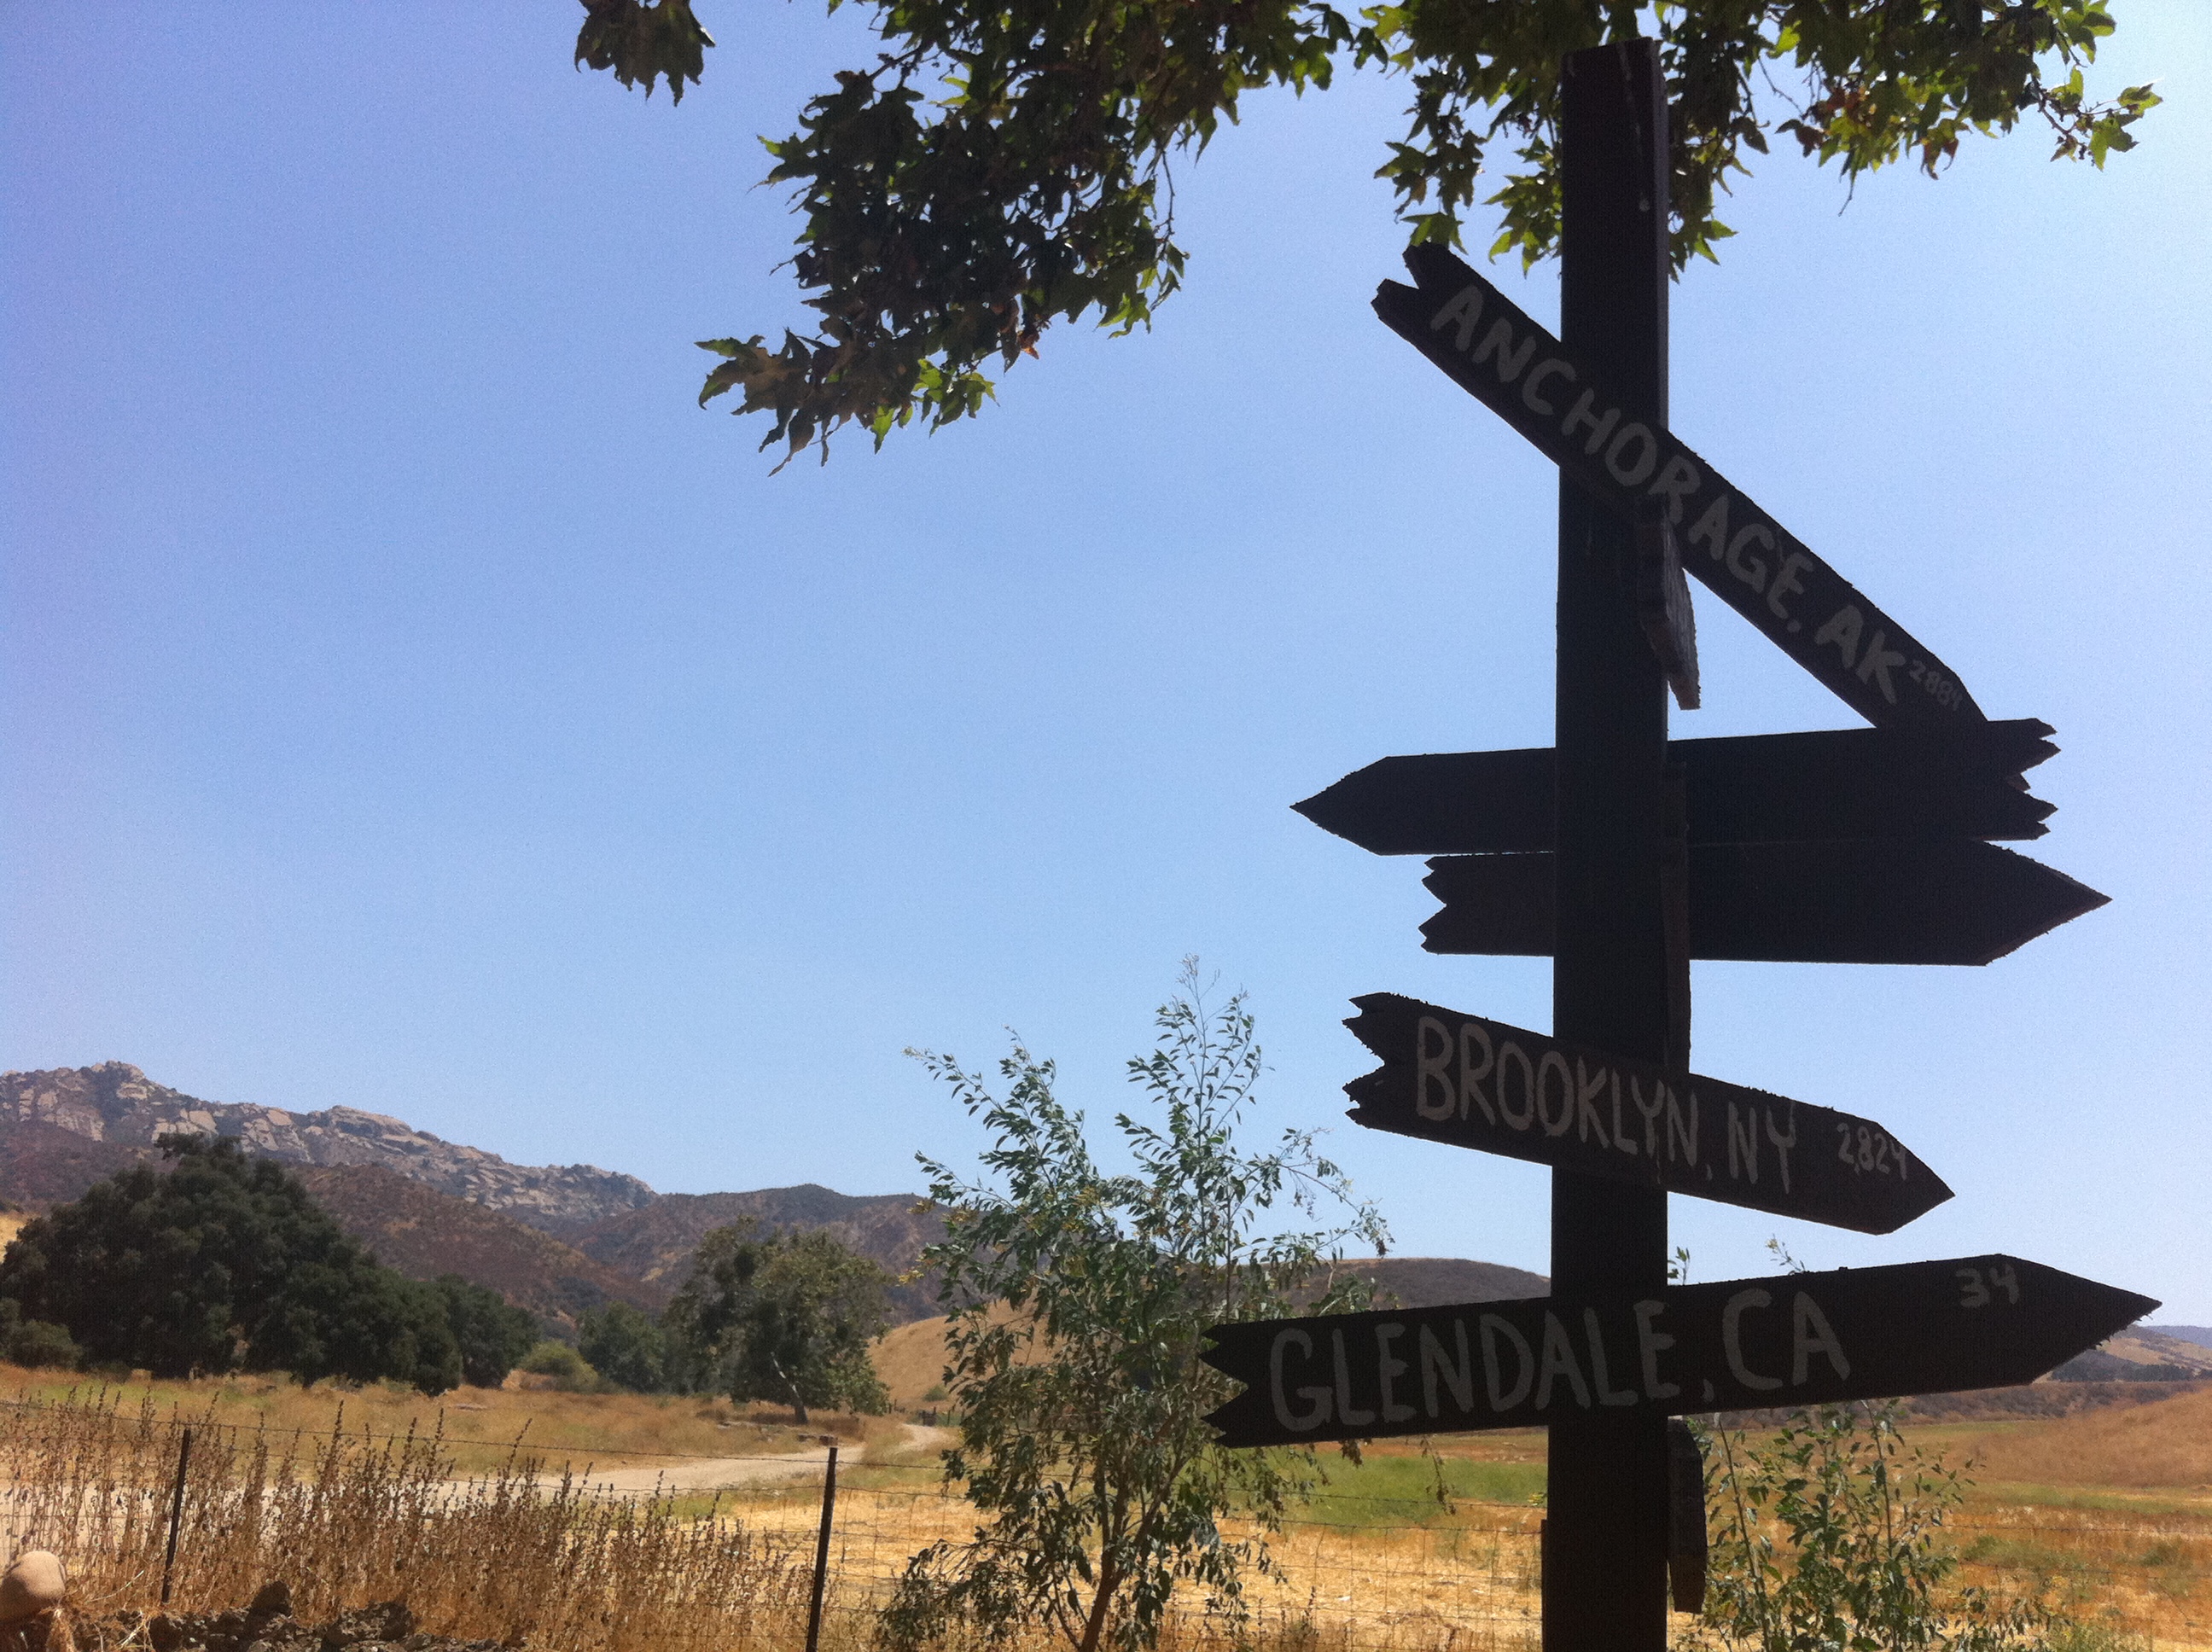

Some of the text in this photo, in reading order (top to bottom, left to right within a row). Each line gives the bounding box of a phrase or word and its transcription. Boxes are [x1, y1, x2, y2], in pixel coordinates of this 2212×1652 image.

[1815, 605, 1906, 705] AK
[1728, 1101, 1797, 1195] NY
[1270, 1265, 2021, 1434] GLENDALE, CA 34
